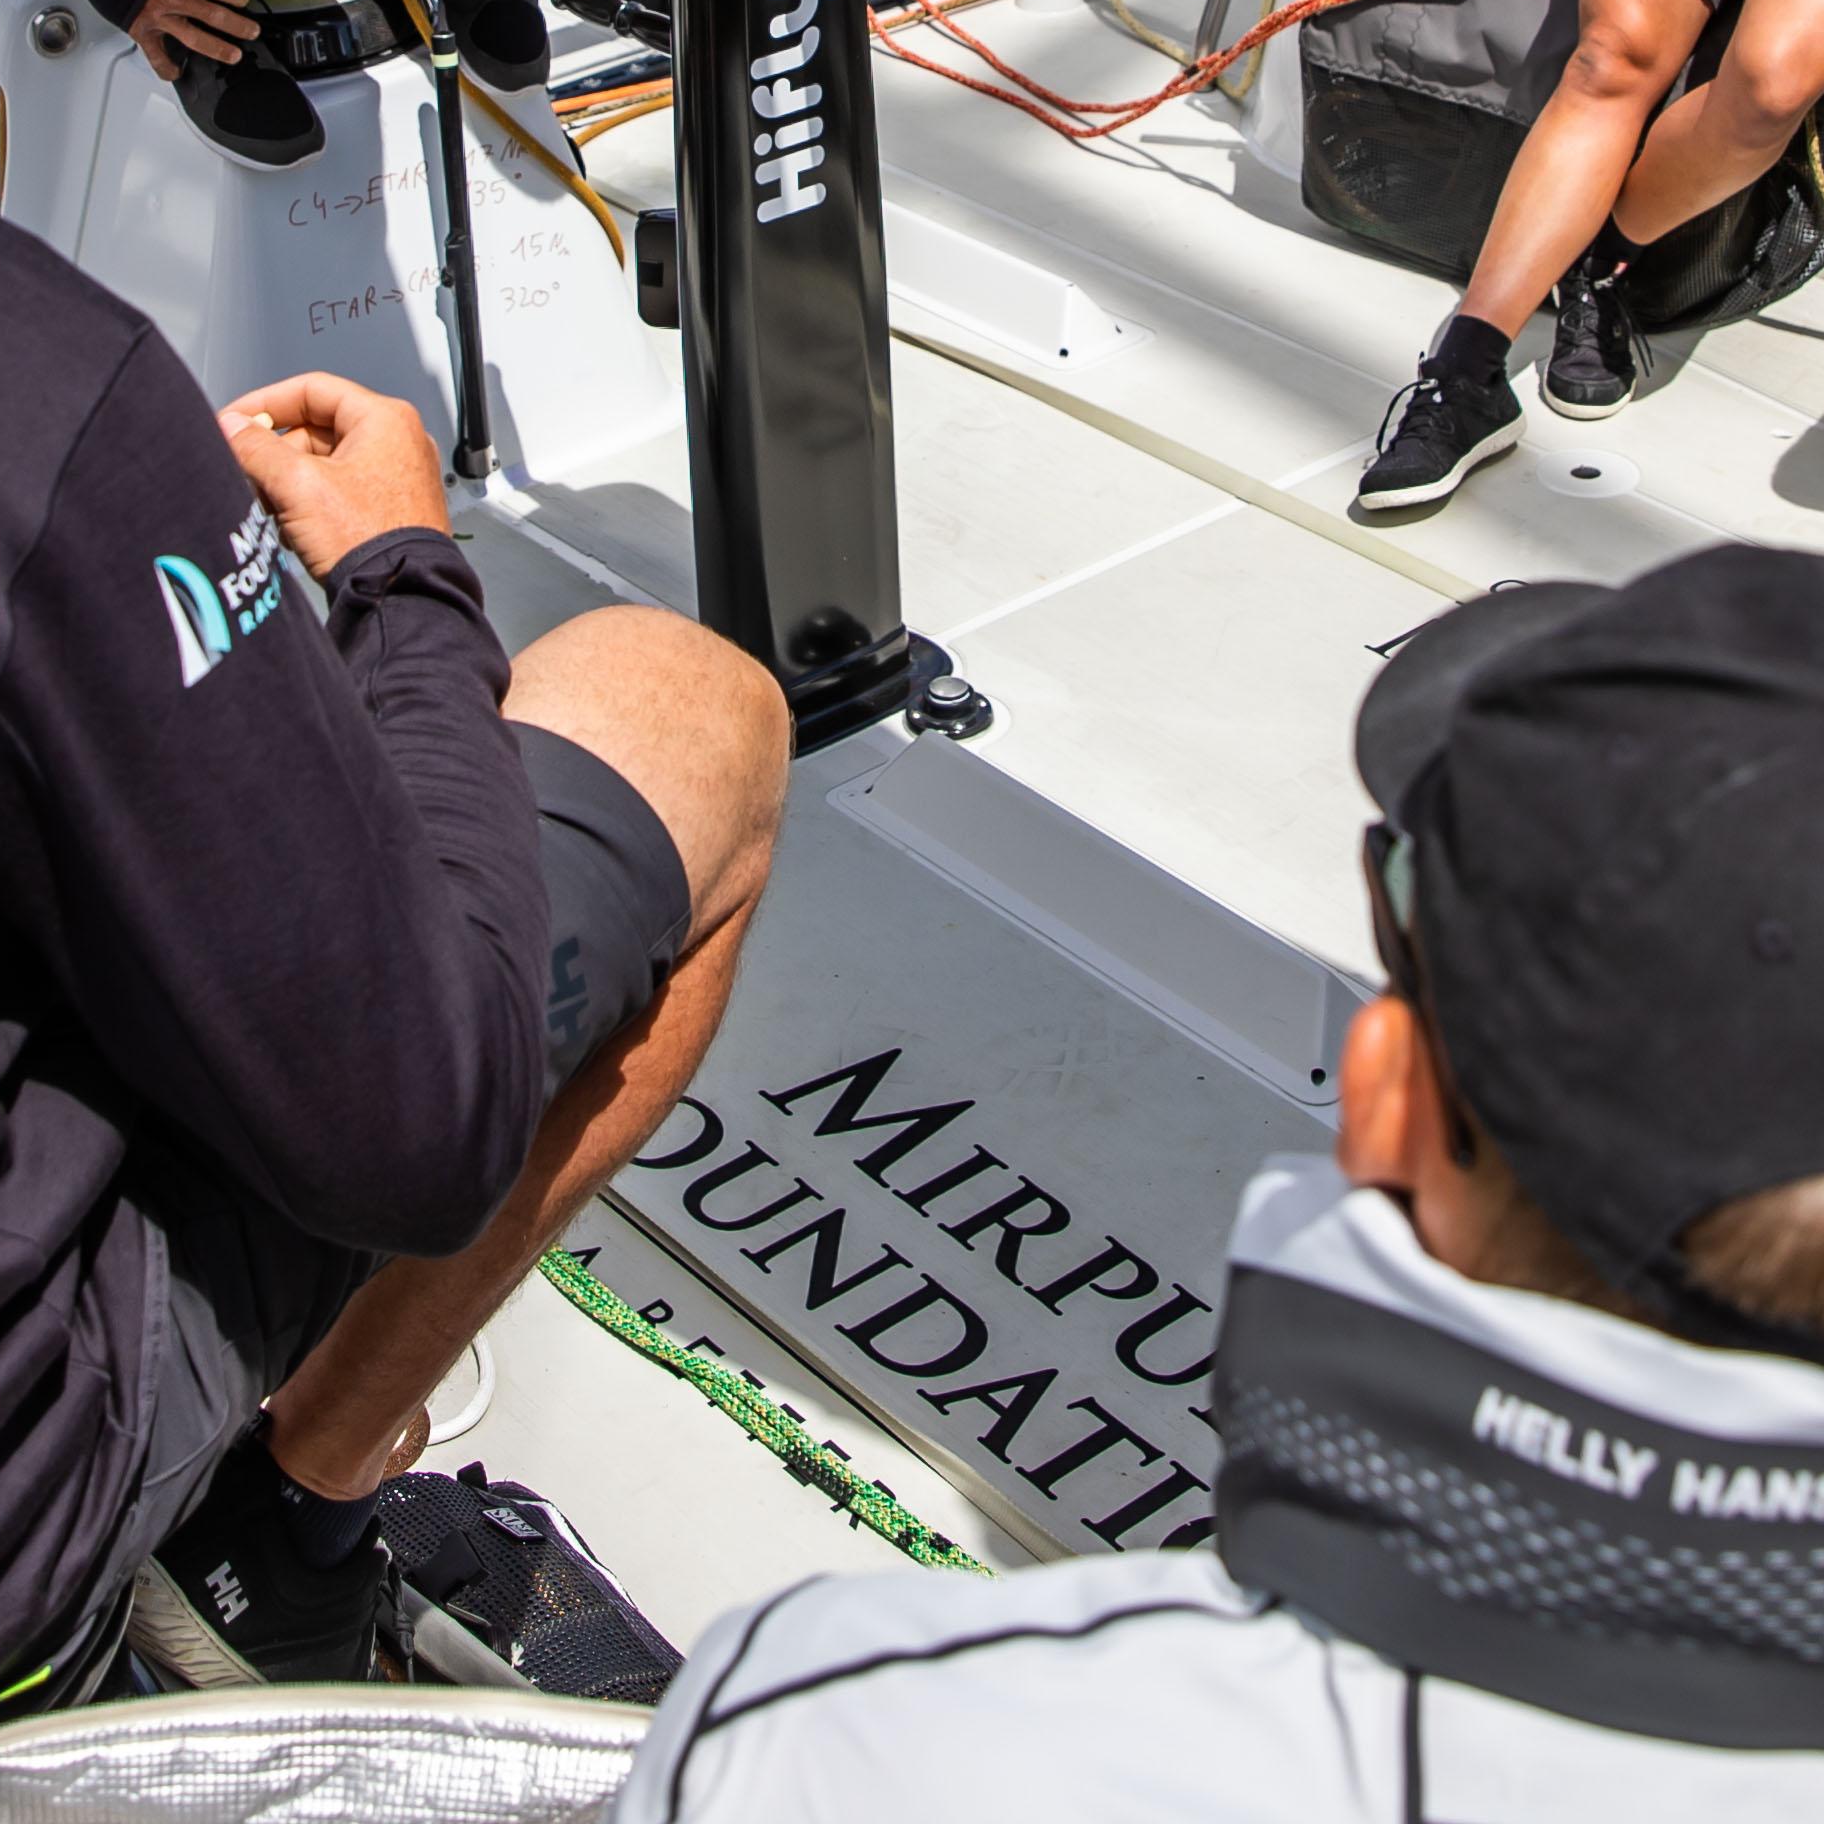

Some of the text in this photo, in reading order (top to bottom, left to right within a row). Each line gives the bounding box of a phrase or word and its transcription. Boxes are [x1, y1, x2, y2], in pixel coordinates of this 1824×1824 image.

[631, 1094, 1219, 1554] OUNDATI
[757, 1047, 1217, 1421] MIRPU
[1473, 1386, 1659, 1498] HELLY
[205, 1560, 250, 1625] HH
